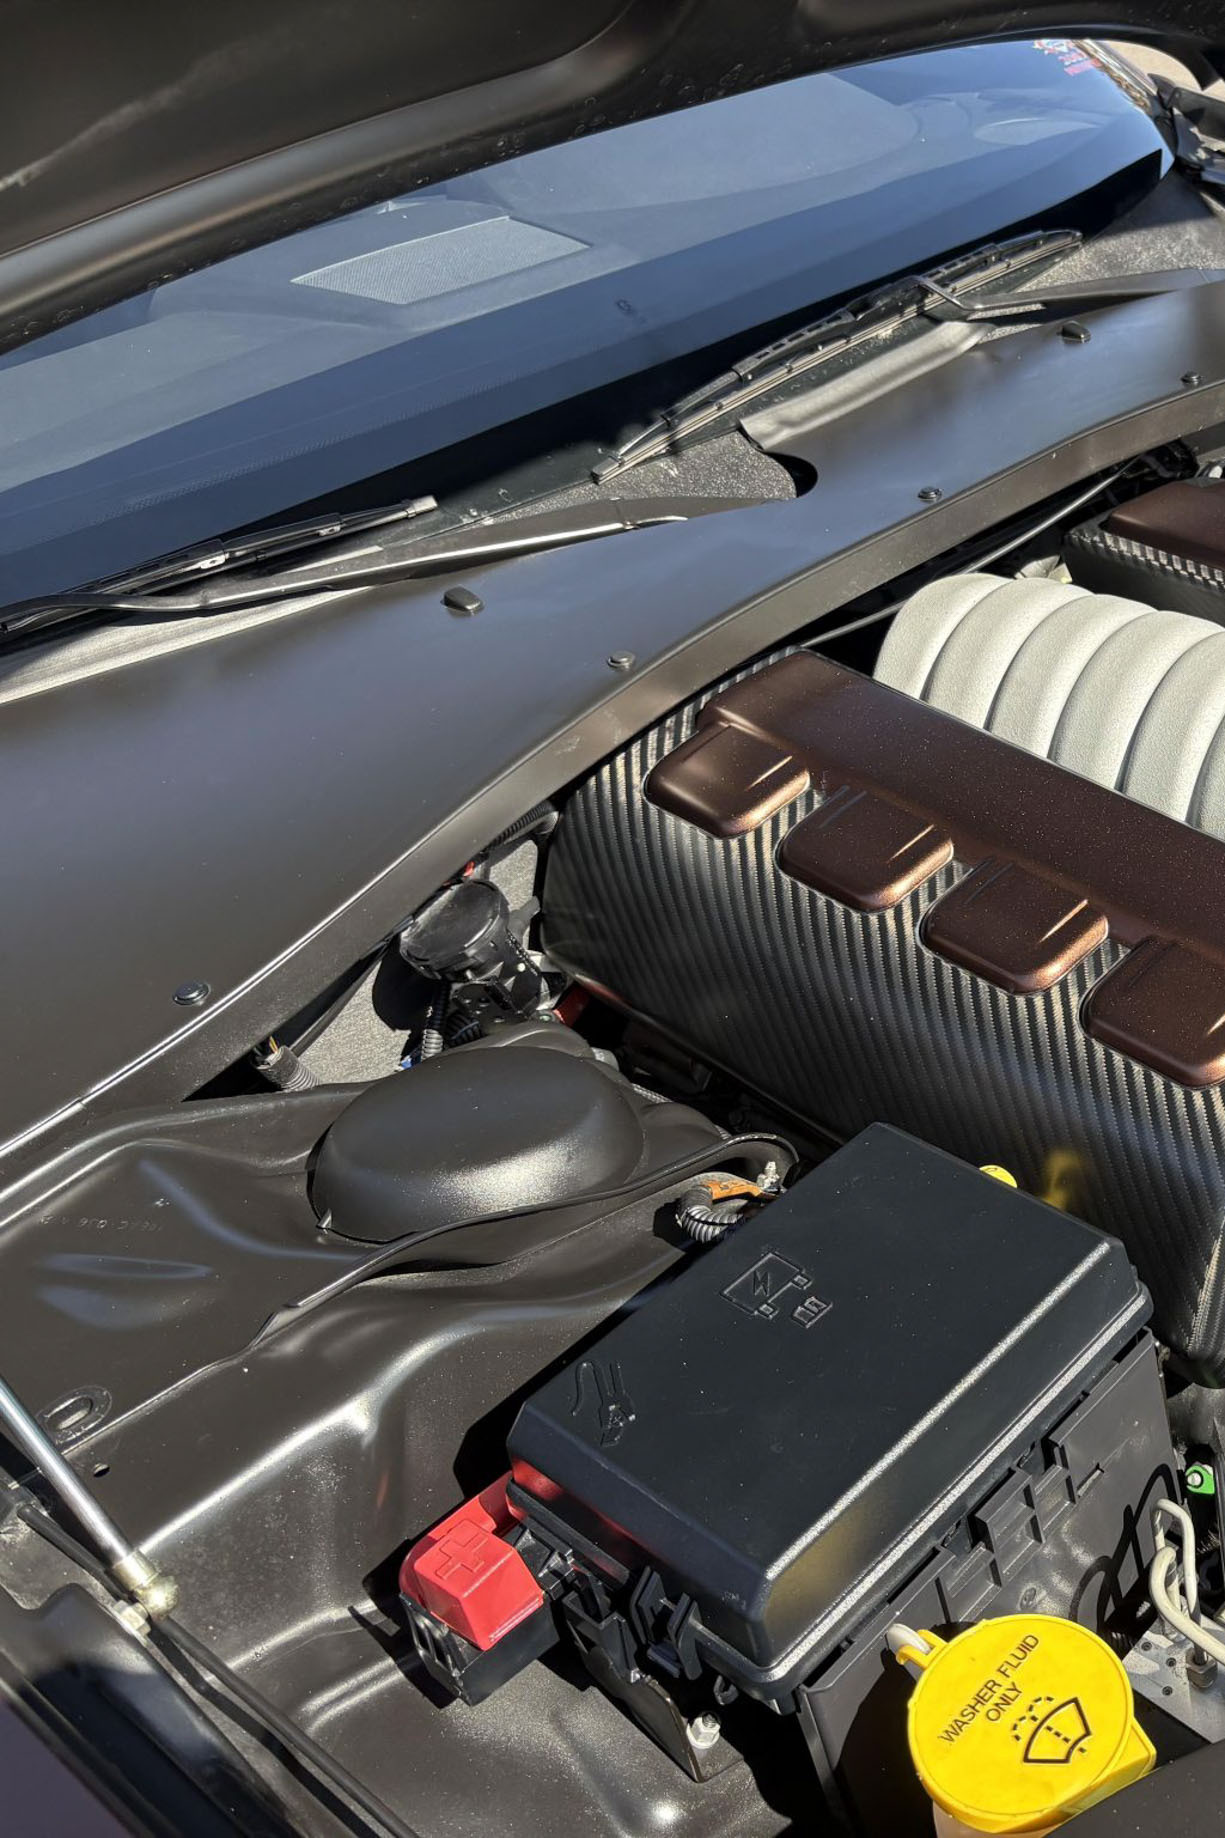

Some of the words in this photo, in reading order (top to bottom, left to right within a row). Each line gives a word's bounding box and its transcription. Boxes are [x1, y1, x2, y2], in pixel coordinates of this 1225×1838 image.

[939, 1679, 1002, 1743] WASHER
[997, 1634, 1040, 1678] FLUID
[986, 1681, 1023, 1722] ONLY
